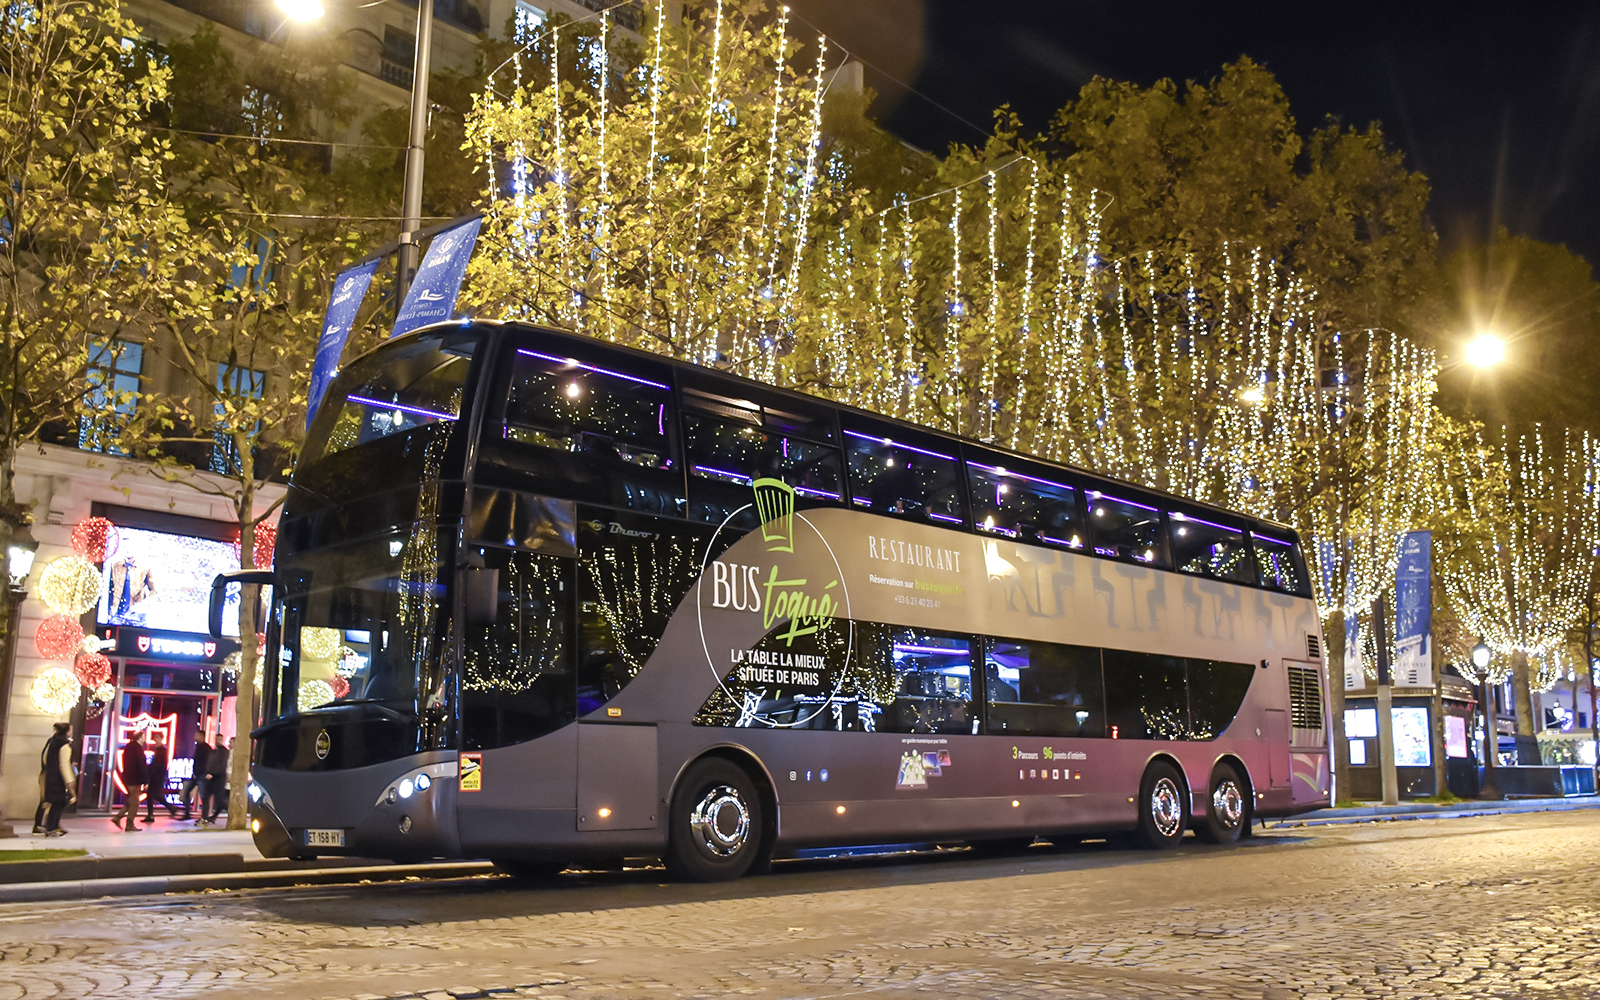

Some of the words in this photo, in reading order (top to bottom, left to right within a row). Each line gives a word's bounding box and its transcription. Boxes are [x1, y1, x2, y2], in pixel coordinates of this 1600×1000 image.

[609, 521, 652, 538] Bravo
[868, 535, 960, 573] RESTAURANT
[869, 573, 904, 588] Réservation
[904, 581, 914, 589] sur
[712, 560, 761, 613] BUS
[763, 565, 838, 647] toqué
[731, 648, 745, 663] LA
[746, 649, 778, 667] TABLE
[780, 653, 794, 668] LA
[795, 653, 826, 670] MIEUX
[739, 666, 775, 684] SITUÉE
[776, 671, 789, 684] DE
[791, 671, 819, 686] PARIS
[1012, 746, 1018, 760] 3
[1018, 750, 1039, 760] Parcours
[1042, 746, 1053, 760] 96
[1053, 751, 1066, 761] points
